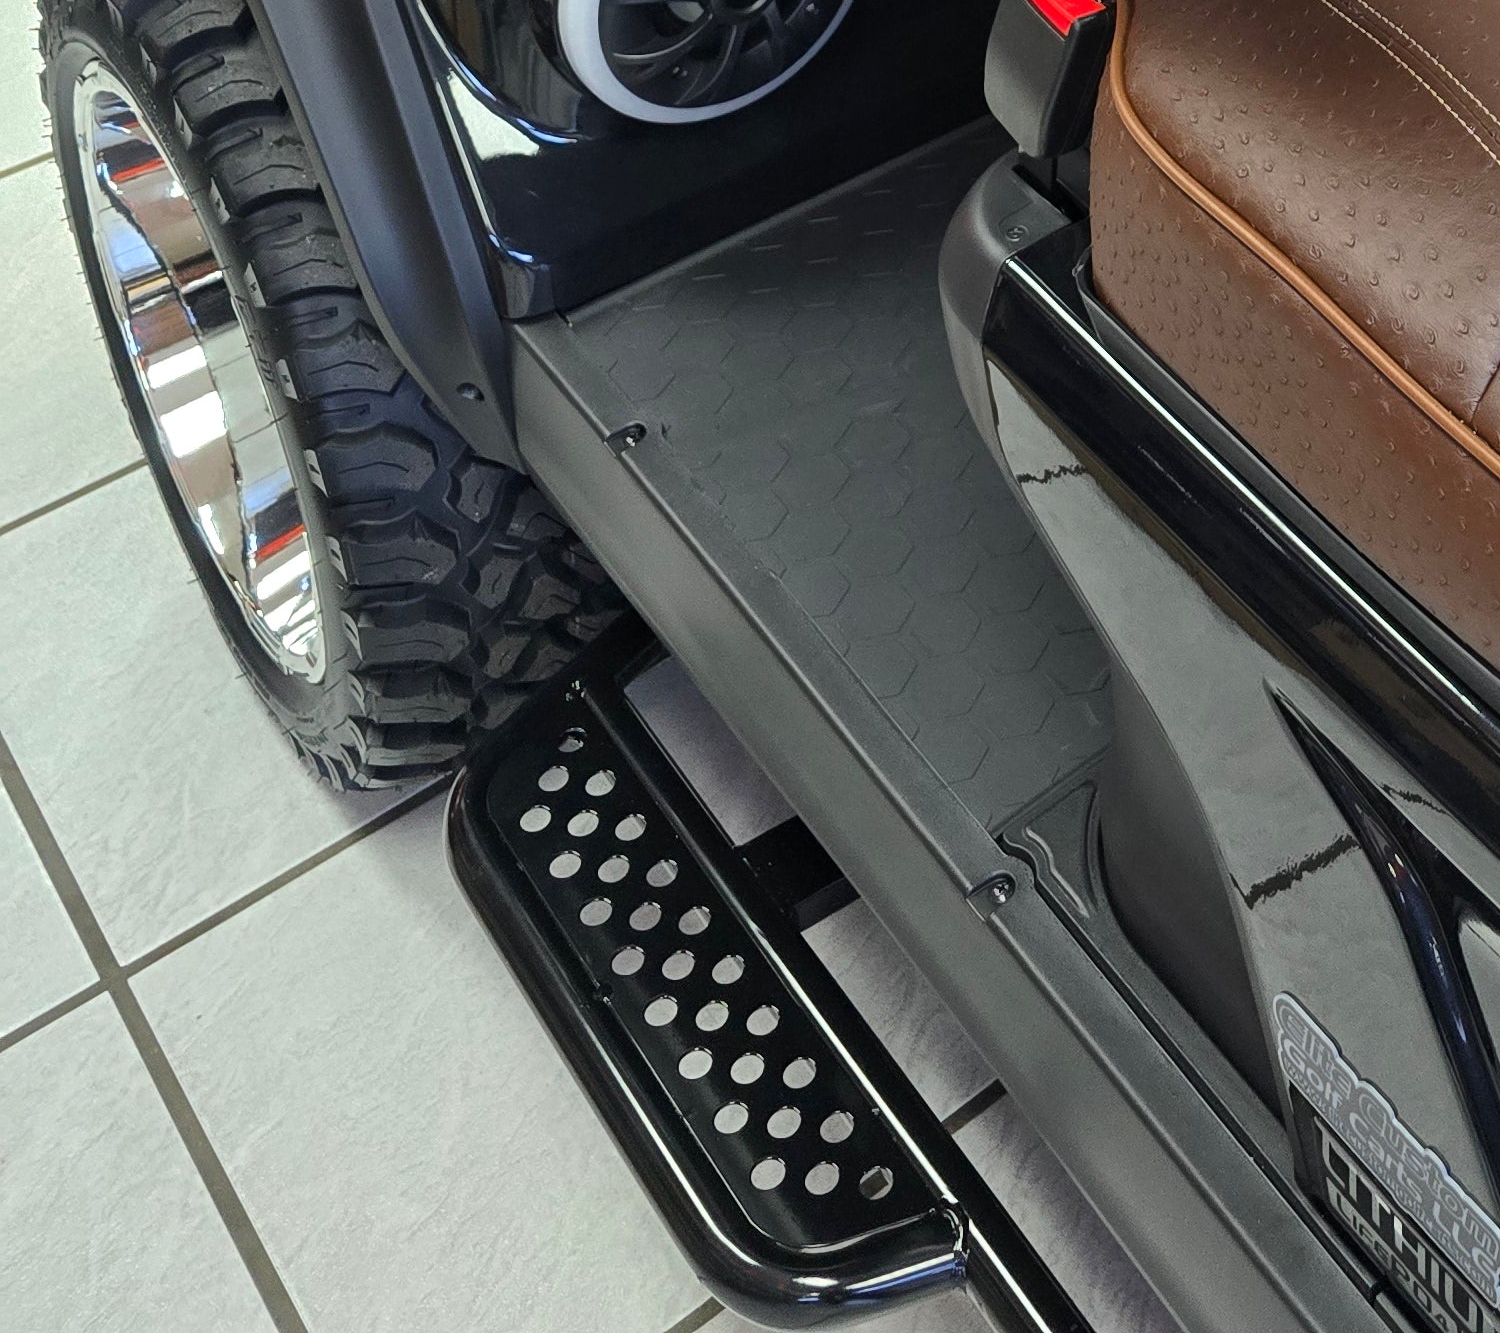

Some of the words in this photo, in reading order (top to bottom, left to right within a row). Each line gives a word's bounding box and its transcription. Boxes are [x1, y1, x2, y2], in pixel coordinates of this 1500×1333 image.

[1283, 1038, 1344, 1109] Golf
[1349, 1112, 1423, 1204] Carts
[1433, 1200, 1496, 1280] LLC
[1314, 1116, 1490, 1333] LITHIU
